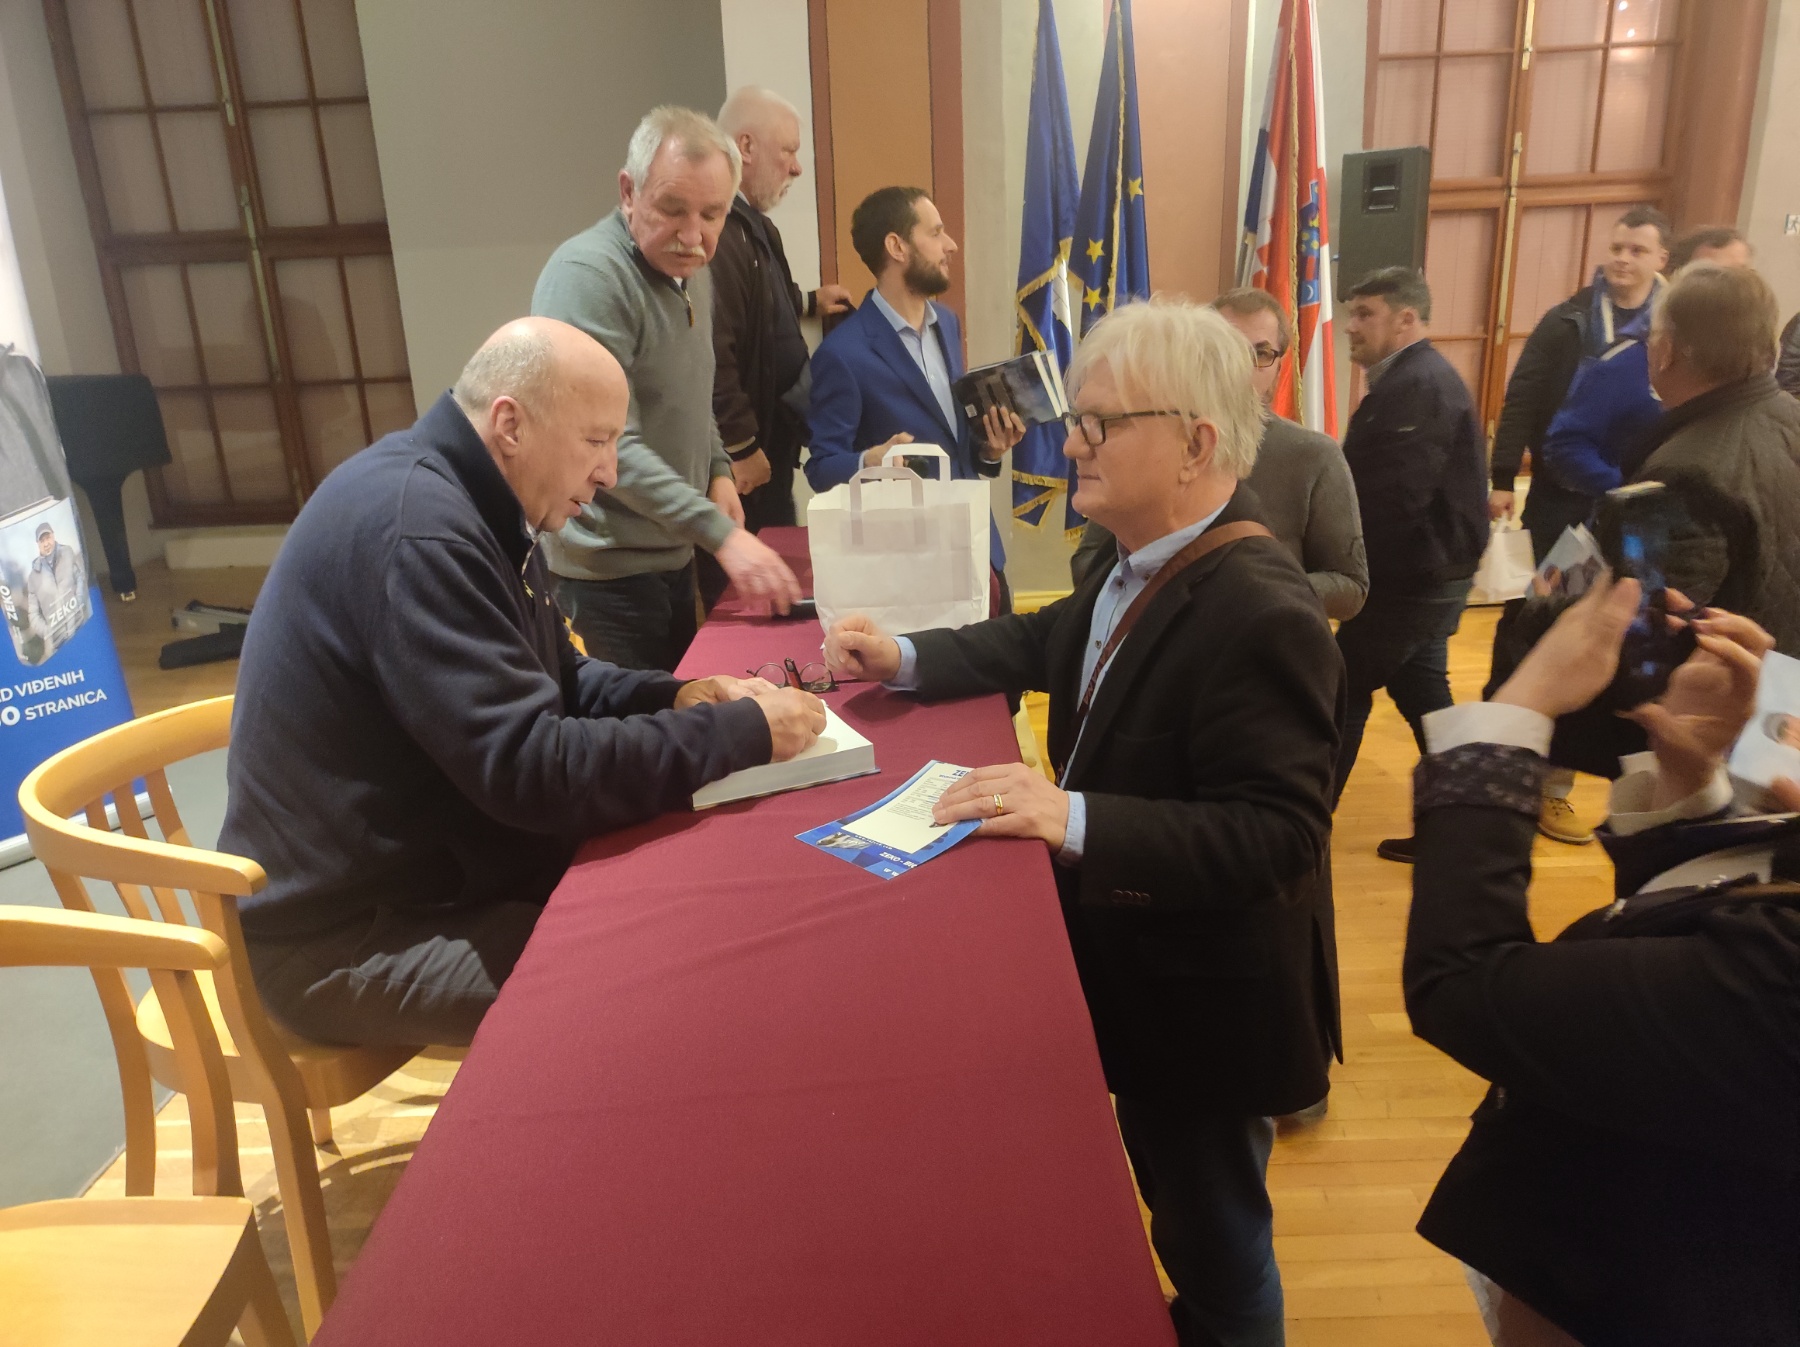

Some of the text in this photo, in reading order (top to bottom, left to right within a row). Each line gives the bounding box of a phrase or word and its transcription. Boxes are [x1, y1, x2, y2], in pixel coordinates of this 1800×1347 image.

[0, 585, 19, 621] ZEKO
[48, 596, 77, 628] ZEKO
[0, 669, 85, 703] D VIĐENIH
[24, 688, 108, 721] STRANICA
